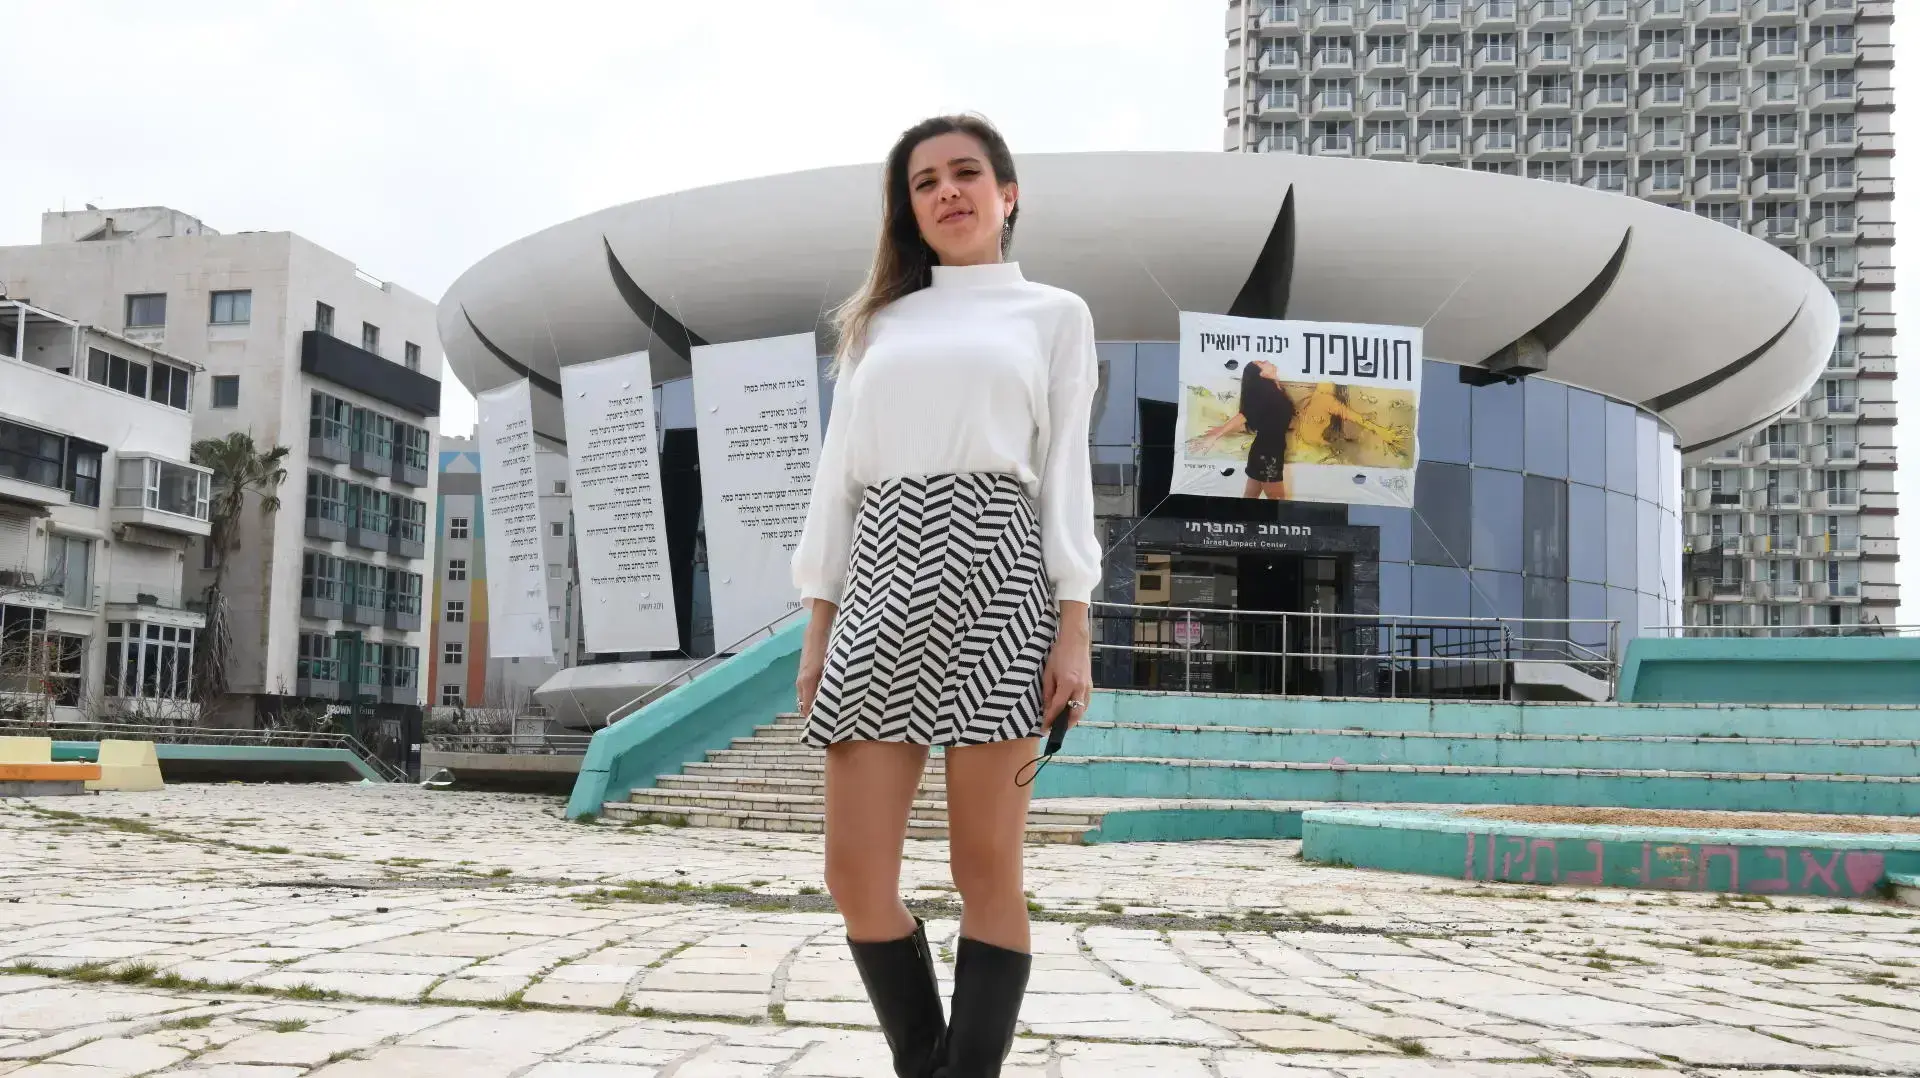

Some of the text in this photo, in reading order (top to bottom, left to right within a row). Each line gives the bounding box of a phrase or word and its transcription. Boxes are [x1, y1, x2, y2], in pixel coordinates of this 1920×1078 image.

[1199, 332, 1412, 382] חושפת ילנה דיוואיין
[774, 422, 788, 430] אחד
[789, 421, 798, 429] צד
[799, 418, 808, 429] על
[800, 432, 809, 442] על
[766, 449, 775, 458] לא
[776, 447, 797, 457] לעולם
[1185, 521, 1311, 536] המרחב החברתי
[1260, 540, 1287, 548] Center
